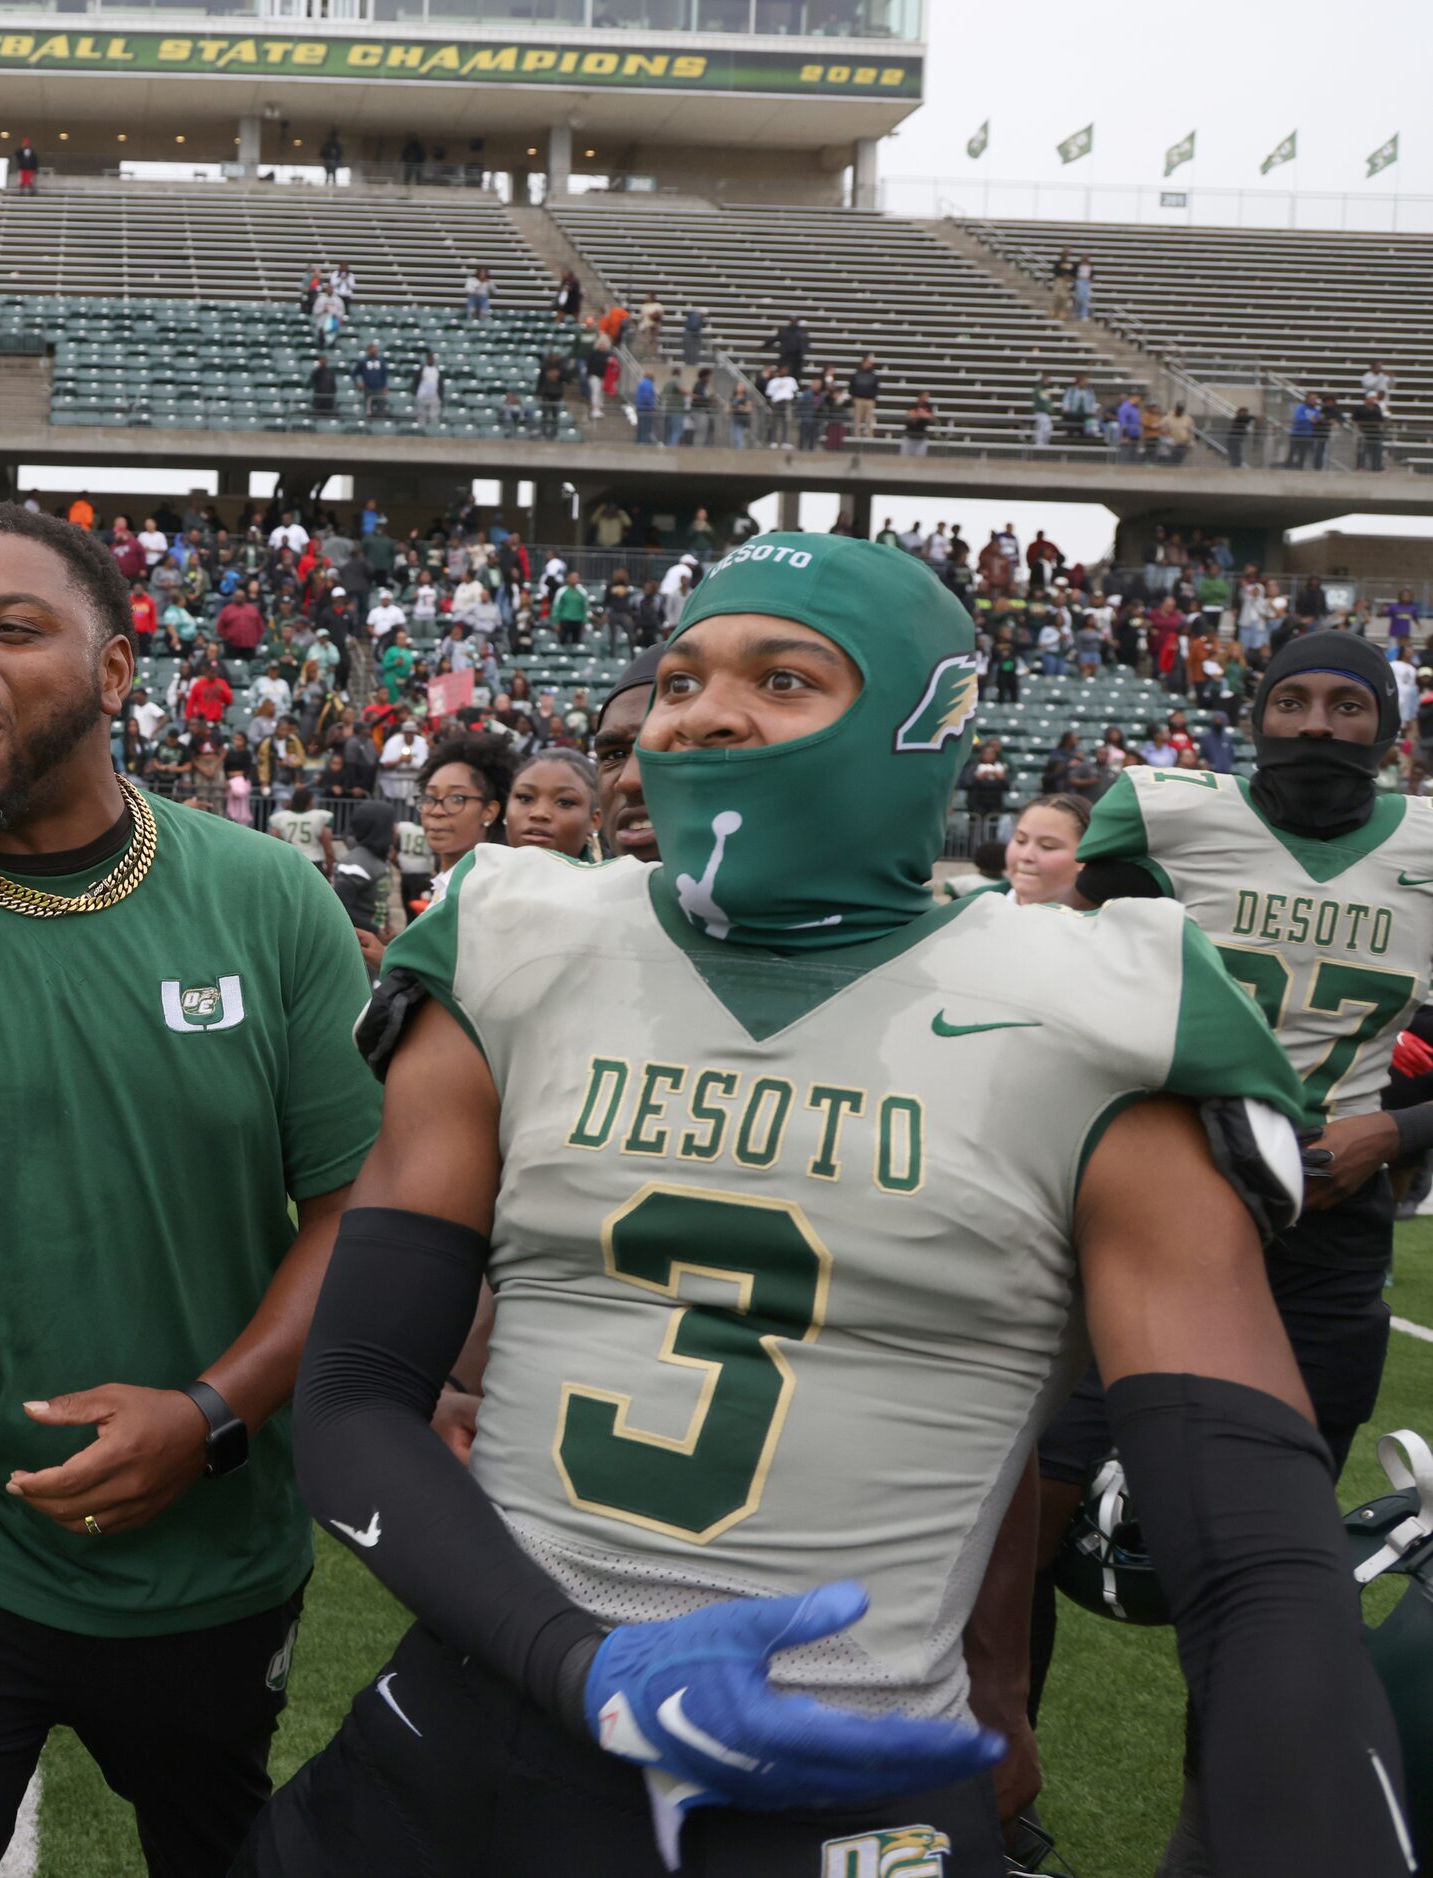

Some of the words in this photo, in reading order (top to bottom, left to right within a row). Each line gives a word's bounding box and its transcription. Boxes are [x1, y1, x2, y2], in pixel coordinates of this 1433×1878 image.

[345, 44, 708, 79] CHAMPIONS
[799, 64, 905, 87] 2022
[287, 821, 312, 844] 75
[405, 833, 425, 855] 18
[1230, 888, 1394, 957] DESOTO
[564, 1056, 927, 1196] DESOTO
[551, 1181, 833, 1547] 3
